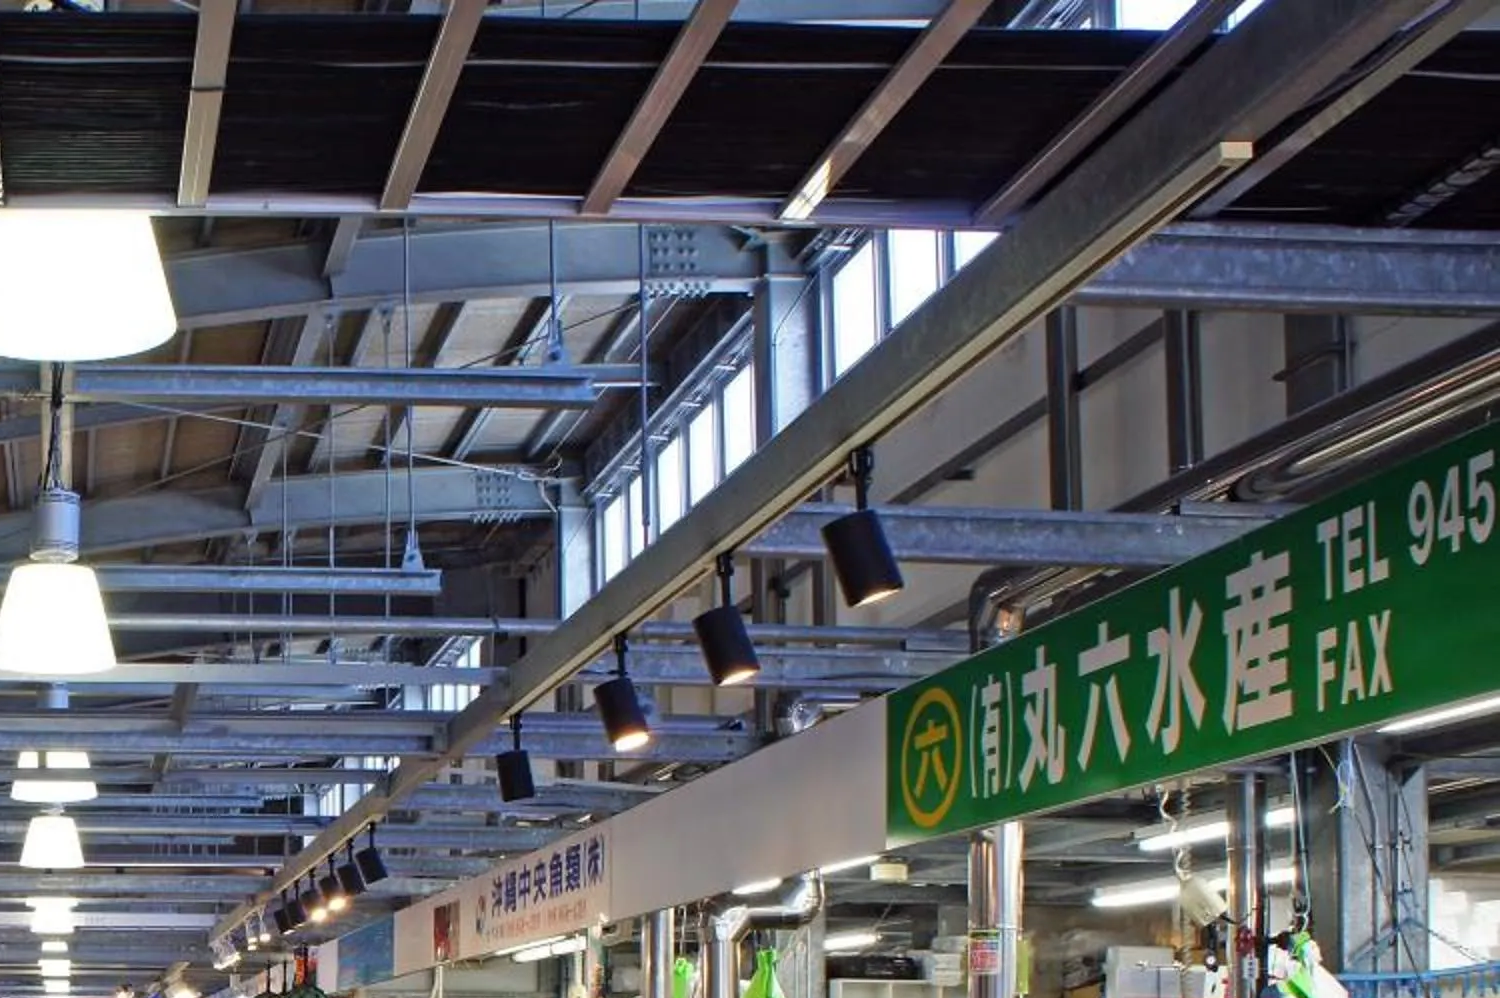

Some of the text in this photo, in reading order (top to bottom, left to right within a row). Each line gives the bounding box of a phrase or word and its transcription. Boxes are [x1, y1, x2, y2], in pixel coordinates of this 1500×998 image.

[1316, 449, 1496, 601] TEL 945
[969, 549, 1294, 799] (有)丸六水産
[1315, 609, 1394, 713] FAX
